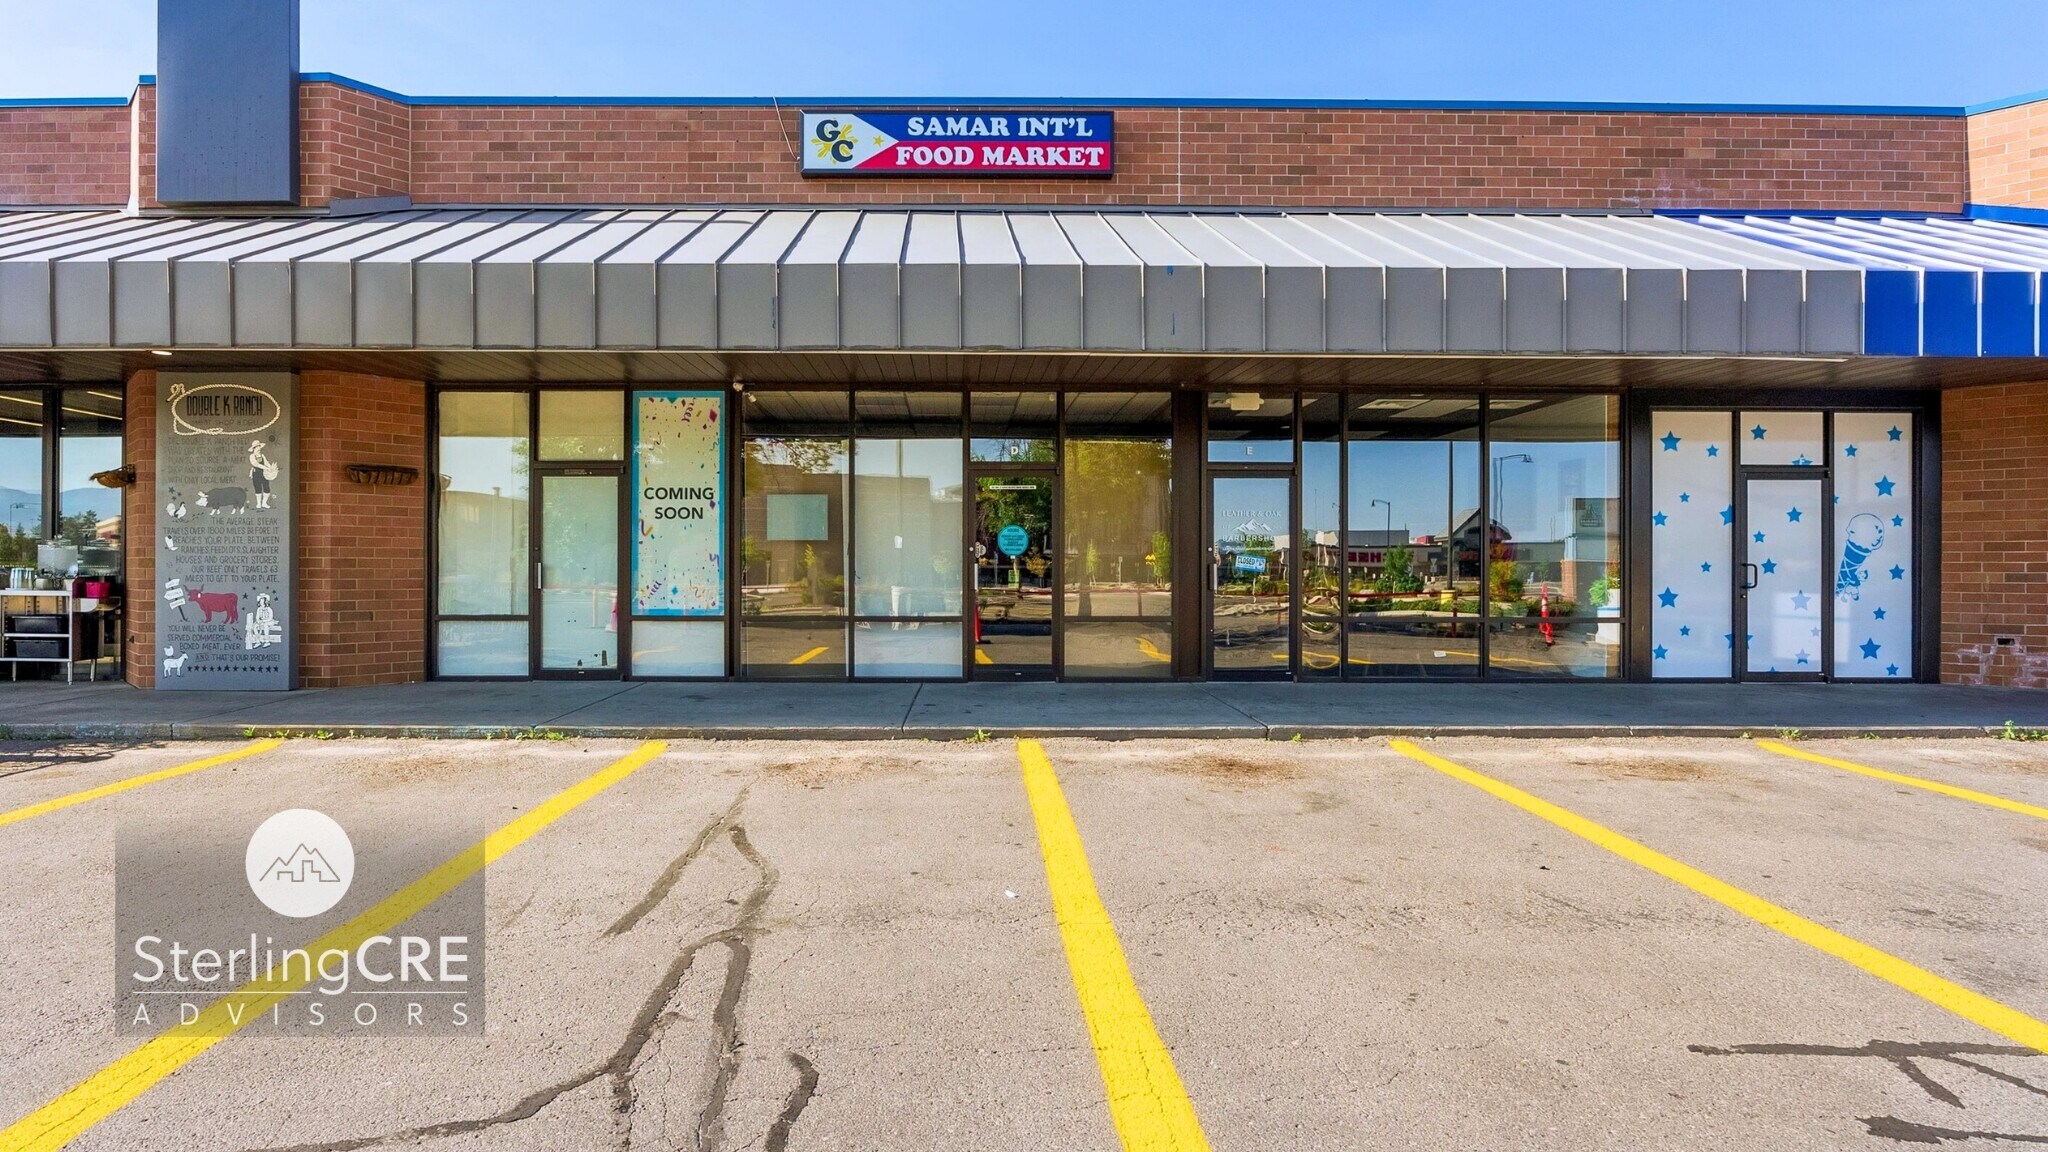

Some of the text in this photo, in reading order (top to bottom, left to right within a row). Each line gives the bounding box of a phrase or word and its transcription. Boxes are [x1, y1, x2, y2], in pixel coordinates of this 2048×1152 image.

[816, 119, 841, 142] G
[907, 116, 1093, 137] SAMAR INT'L
[831, 140, 853, 163] C
[895, 146, 1104, 166] FOOD MARKET
[186, 395, 263, 416] DOUBLE K RANCH
[1011, 446, 1019, 455] D
[1246, 446, 1253, 455] E
[643, 487, 714, 500] COMING
[654, 507, 704, 520] SOON
[1264, 510, 1282, 518] OAK
[211, 517, 278, 525] THE AVERAGE STEAK
[163, 526, 189, 535] TRAVELS
[190, 527, 205, 535] OVER
[227, 527, 246, 535] MILES
[247, 527, 271, 535] BEFORE
[273, 527, 280, 535] IT
[173, 536, 202, 544] REACHES
[205, 536, 222, 544] YOUR
[248, 536, 280, 544] BETWEEN
[1222, 534, 1280, 542] BARBERSHO
[242, 546, 279, 554] SLAUGHTER
[175, 555, 202, 564] HOUSES
[205, 556, 217, 564] AND
[219, 556, 248, 564] GROCERY
[1237, 556, 1256, 566] CLOSED
[191, 565, 279, 573] OUR BEEF ONLY TRAVELS 63
[185, 575, 204, 583] MILES
[206, 575, 214, 583] TO
[216, 575, 229, 583] GET
[232, 575, 239, 583] TO
[240, 575, 257, 583] YOUR
[167, 634, 232, 642] SERVED COMMERCIAL
[212, 654, 234, 662] THAT'S
